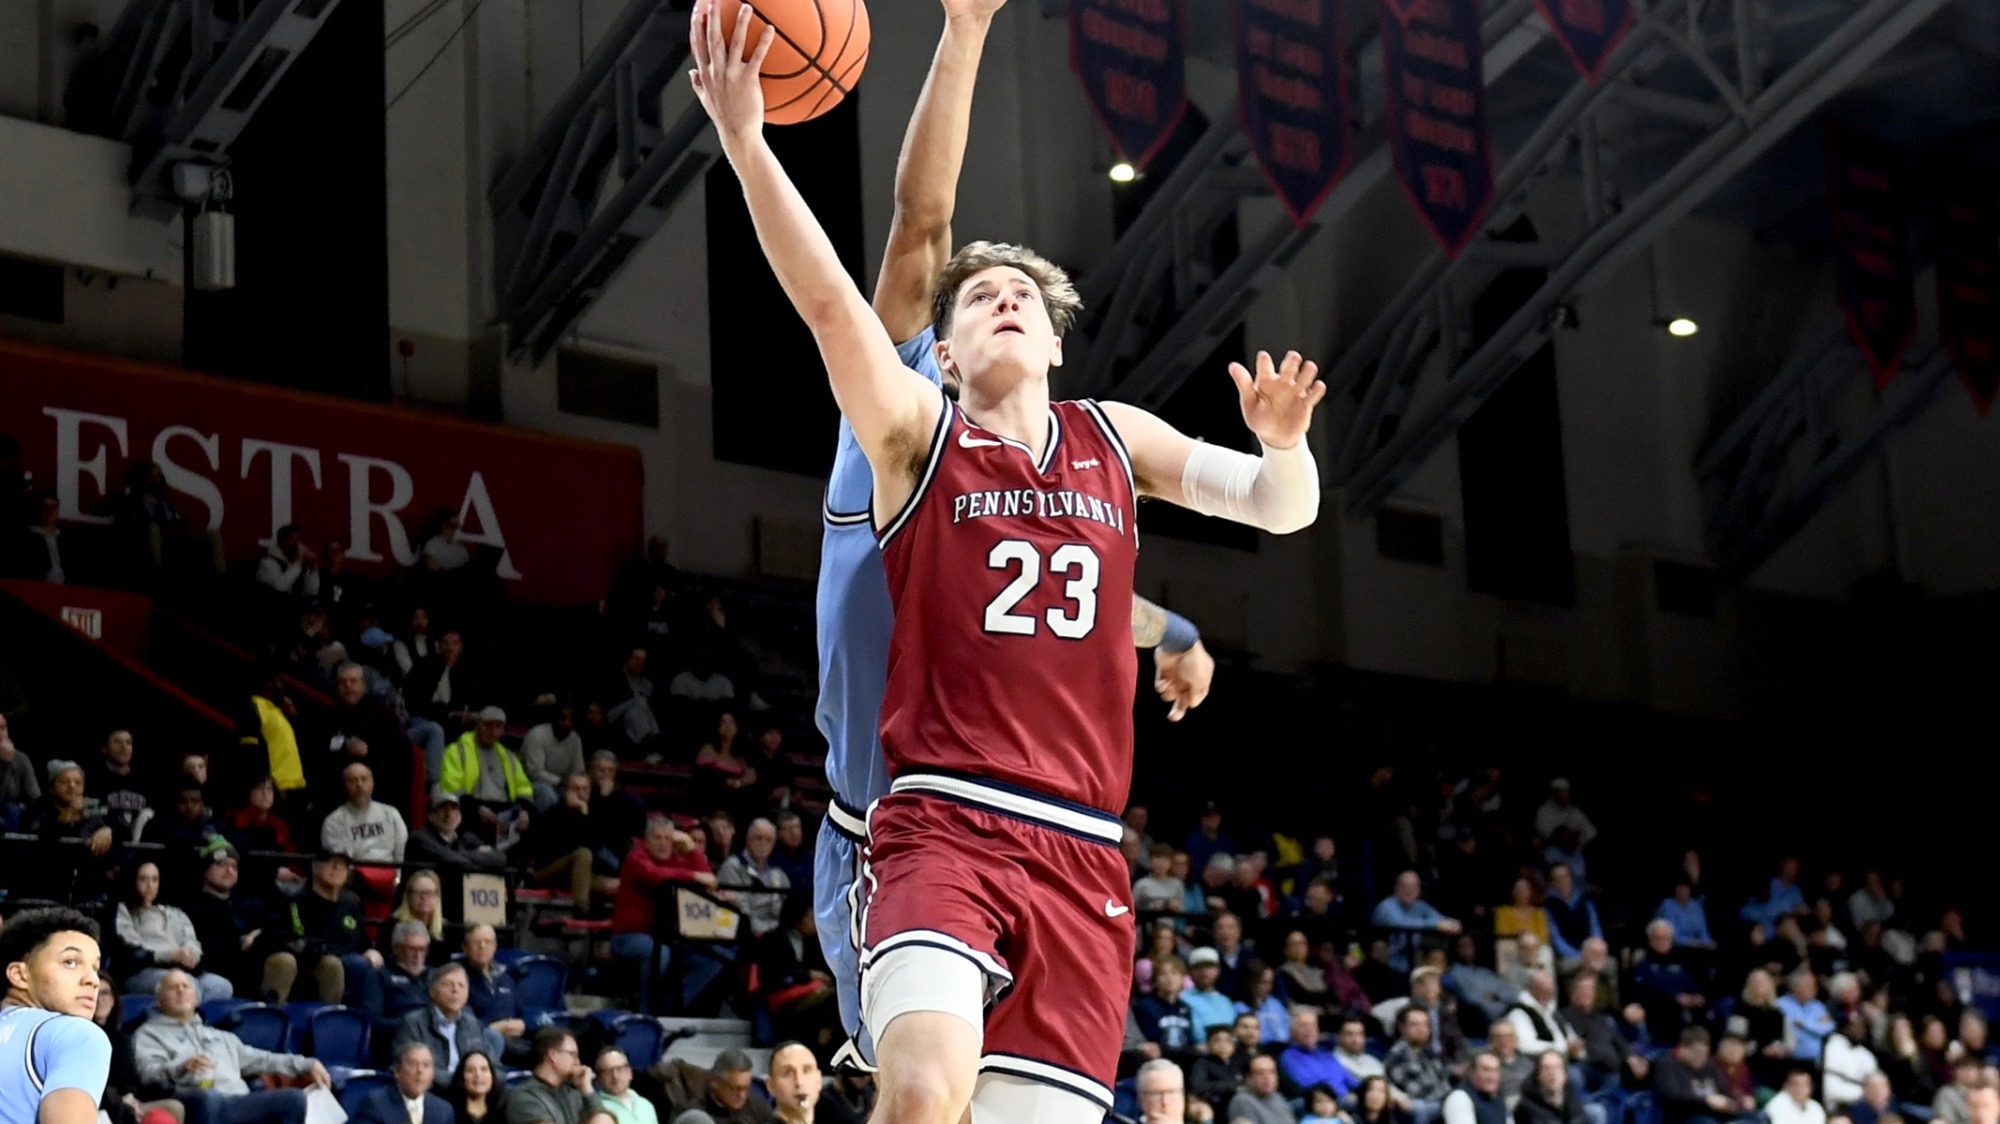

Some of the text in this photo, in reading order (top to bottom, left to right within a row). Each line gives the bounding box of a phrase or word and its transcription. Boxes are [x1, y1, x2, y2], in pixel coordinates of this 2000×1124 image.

[953, 488, 1125, 536] PENNSYLVANIA
[983, 538, 1101, 640] 23
[350, 822, 385, 841] PENN
[471, 888, 499, 908] 103
[685, 901, 711, 920] 104
